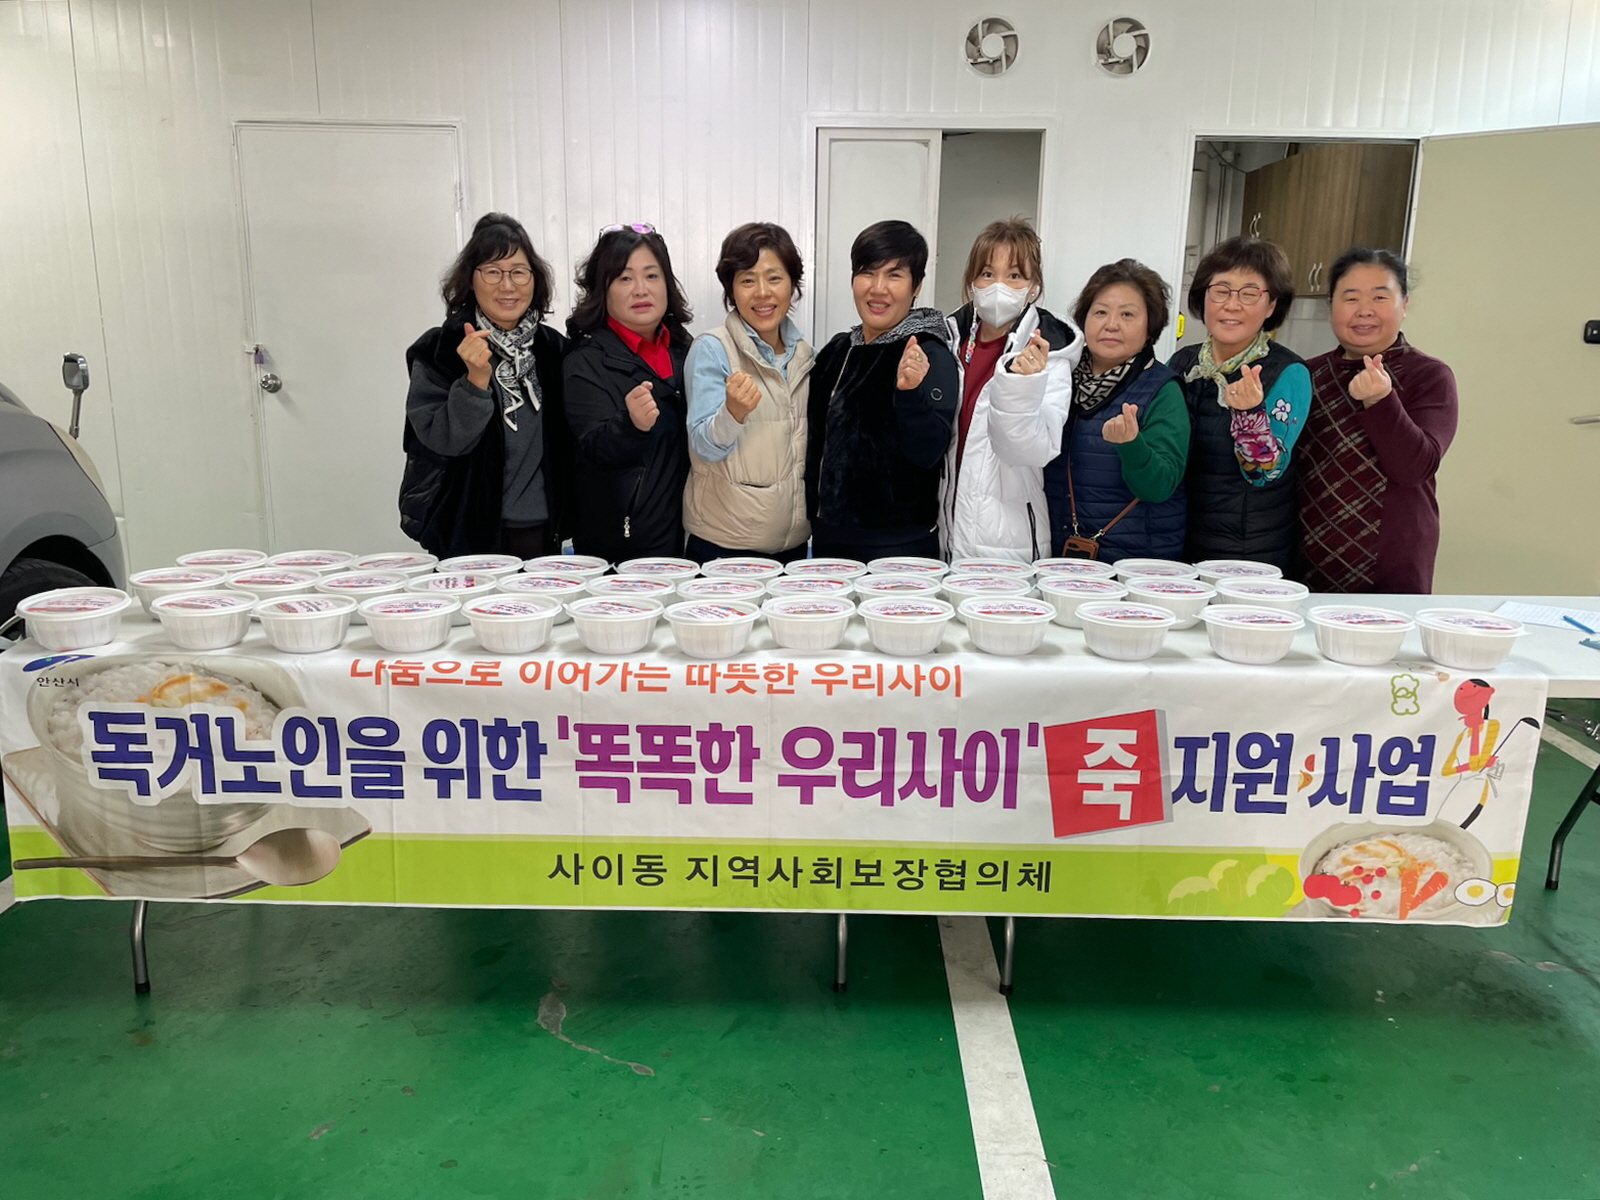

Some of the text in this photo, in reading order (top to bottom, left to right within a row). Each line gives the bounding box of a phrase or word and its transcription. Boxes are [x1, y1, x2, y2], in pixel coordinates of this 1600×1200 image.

[36, 676, 79, 687] 안산시
[350, 658, 963, 697] 나눔으로 이어가는 따뜻한 우리사이
[88, 711, 407, 799] 독거노인을
[422, 718, 548, 802] 위한
[777, 722, 1040, 810] 우리사이'
[1077, 729, 1141, 820] 죽
[1171, 732, 1294, 814] 지원
[1308, 734, 1436, 816] 사업
[548, 853, 1053, 893] 사이동 지역사회보장협의체
